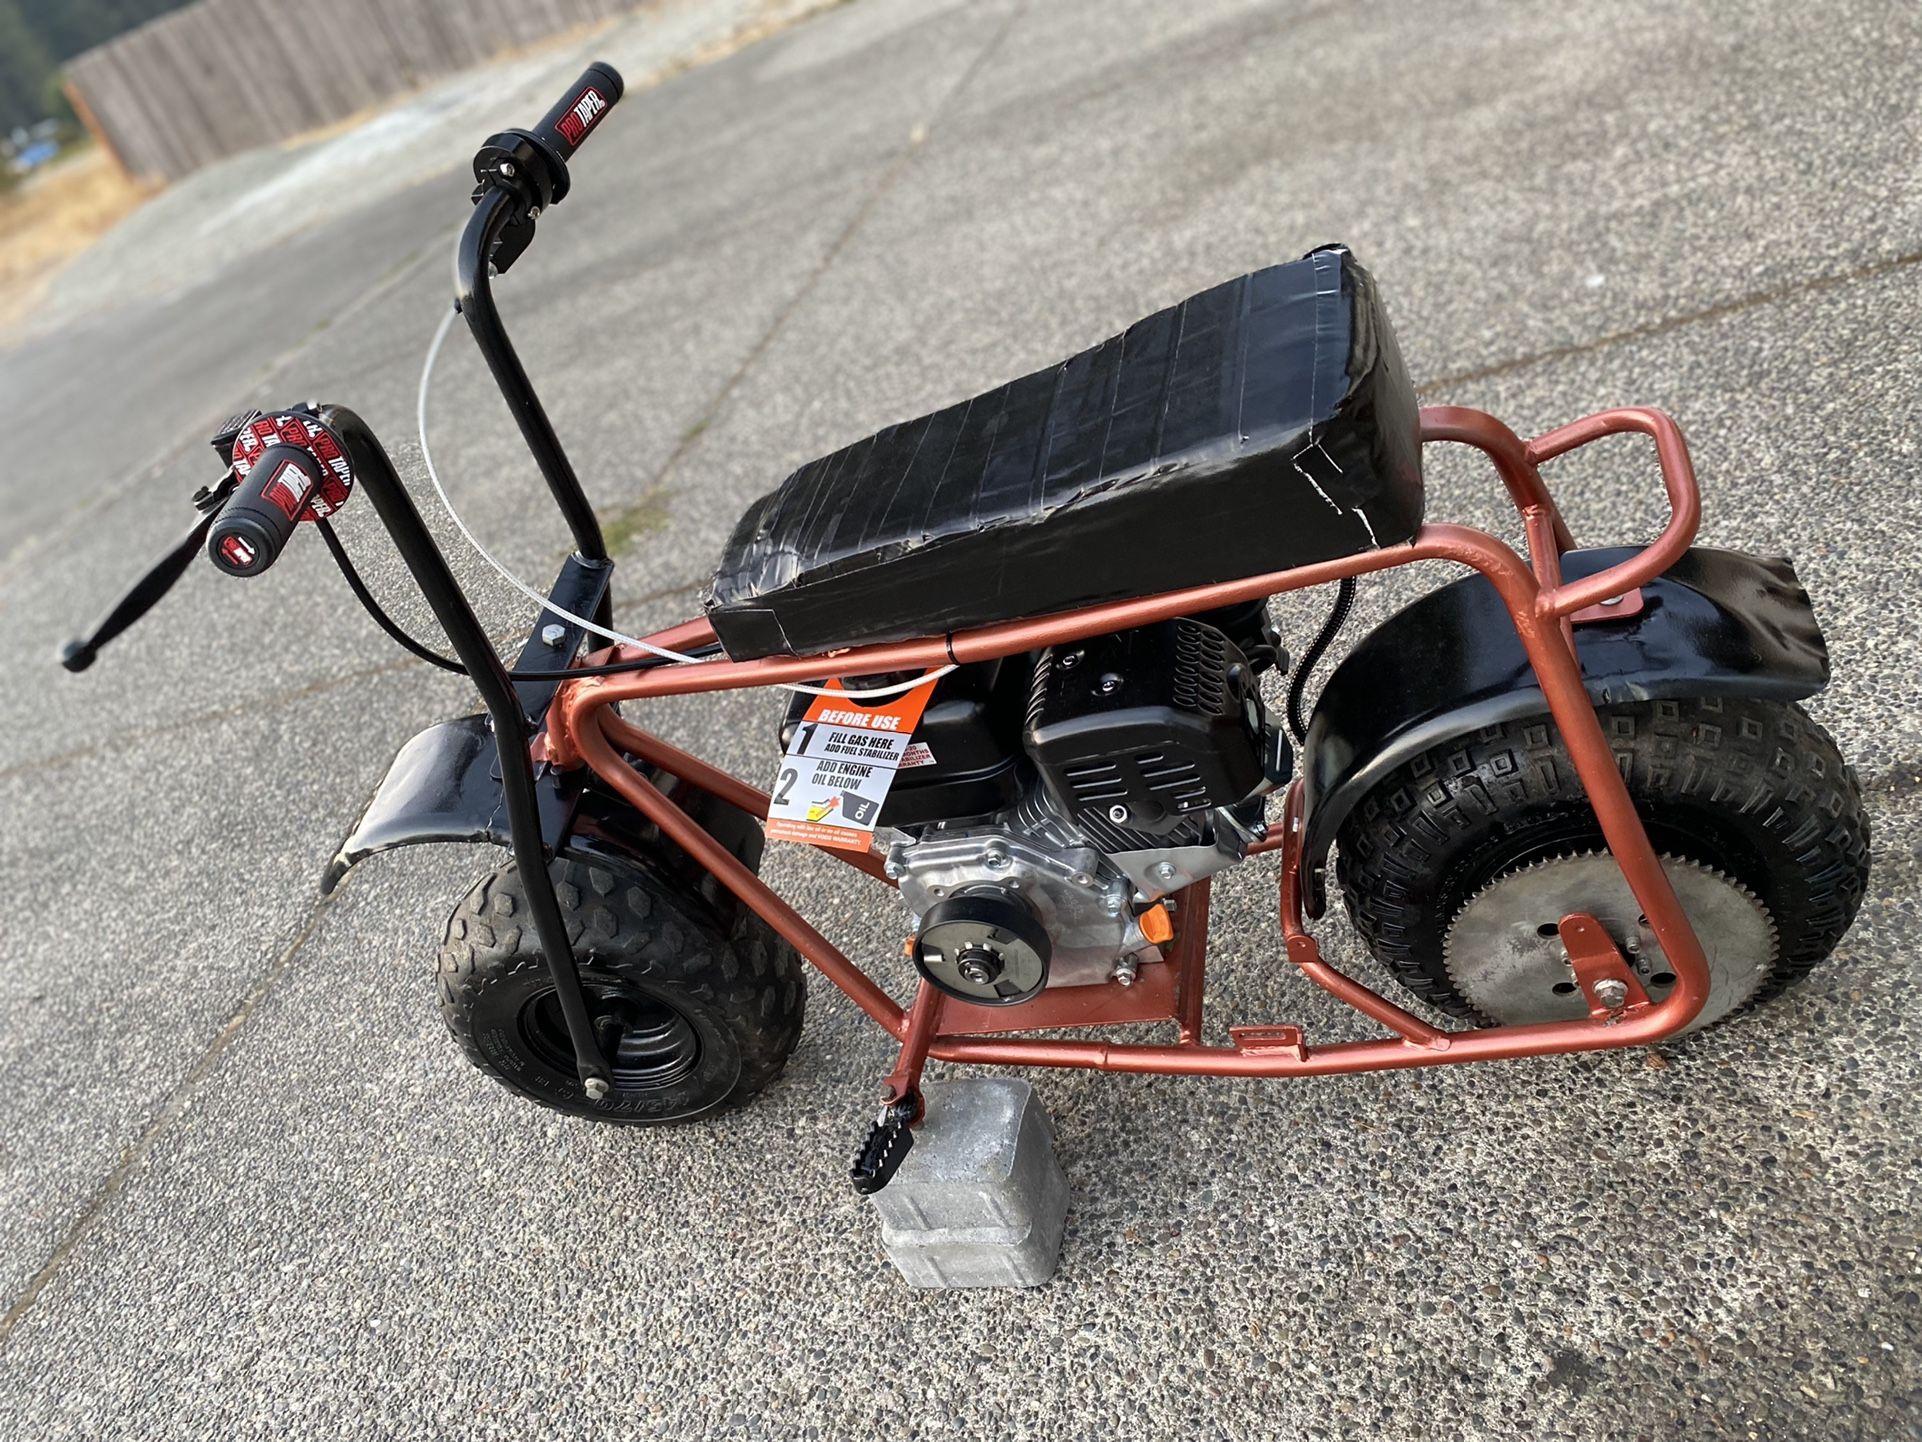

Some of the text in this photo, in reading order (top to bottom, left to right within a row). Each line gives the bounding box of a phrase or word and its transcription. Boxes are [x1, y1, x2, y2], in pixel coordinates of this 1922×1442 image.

[561, 90, 605, 137] PRO TAPER
[819, 709, 901, 731] BEFORE USE
[797, 723, 819, 755] 1
[828, 732, 895, 750] FILL GAS HERE
[824, 743, 900, 761] ADD FUEL STABILIZER
[816, 760, 873, 778] ADD ENGINE
[773, 768, 798, 806] 2
[811, 773, 862, 790] OIL BELOW
[855, 801, 871, 820] OIL
